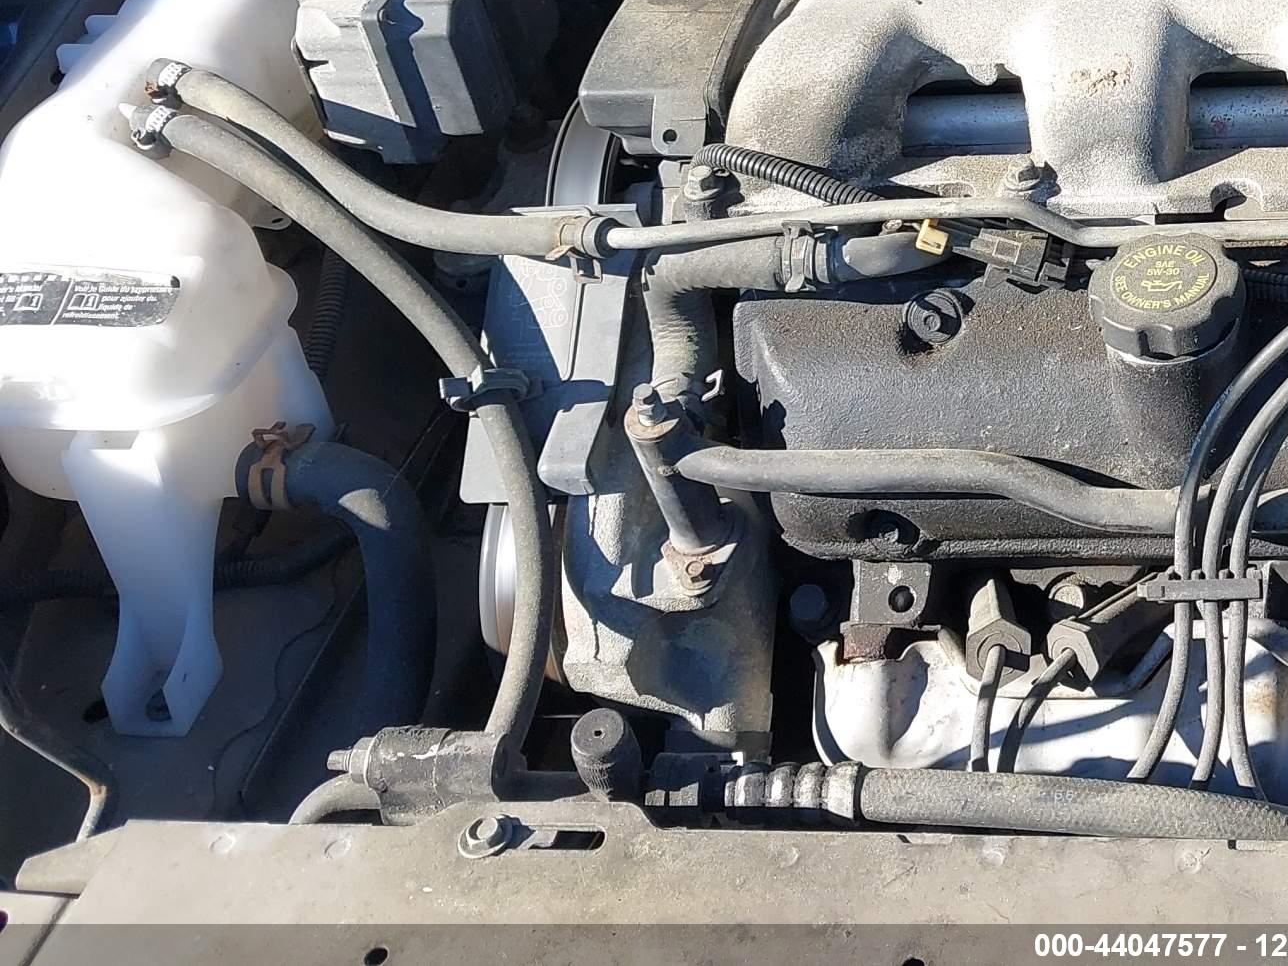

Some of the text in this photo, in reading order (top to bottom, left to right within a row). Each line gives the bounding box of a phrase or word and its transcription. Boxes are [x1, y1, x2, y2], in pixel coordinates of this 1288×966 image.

[1124, 244, 1206, 269] ENGINE OIL
[1155, 260, 1176, 268] SAE
[1146, 267, 1180, 276] 5W-30
[1114, 272, 1210, 310] SEE OWNER'S MANUAL
